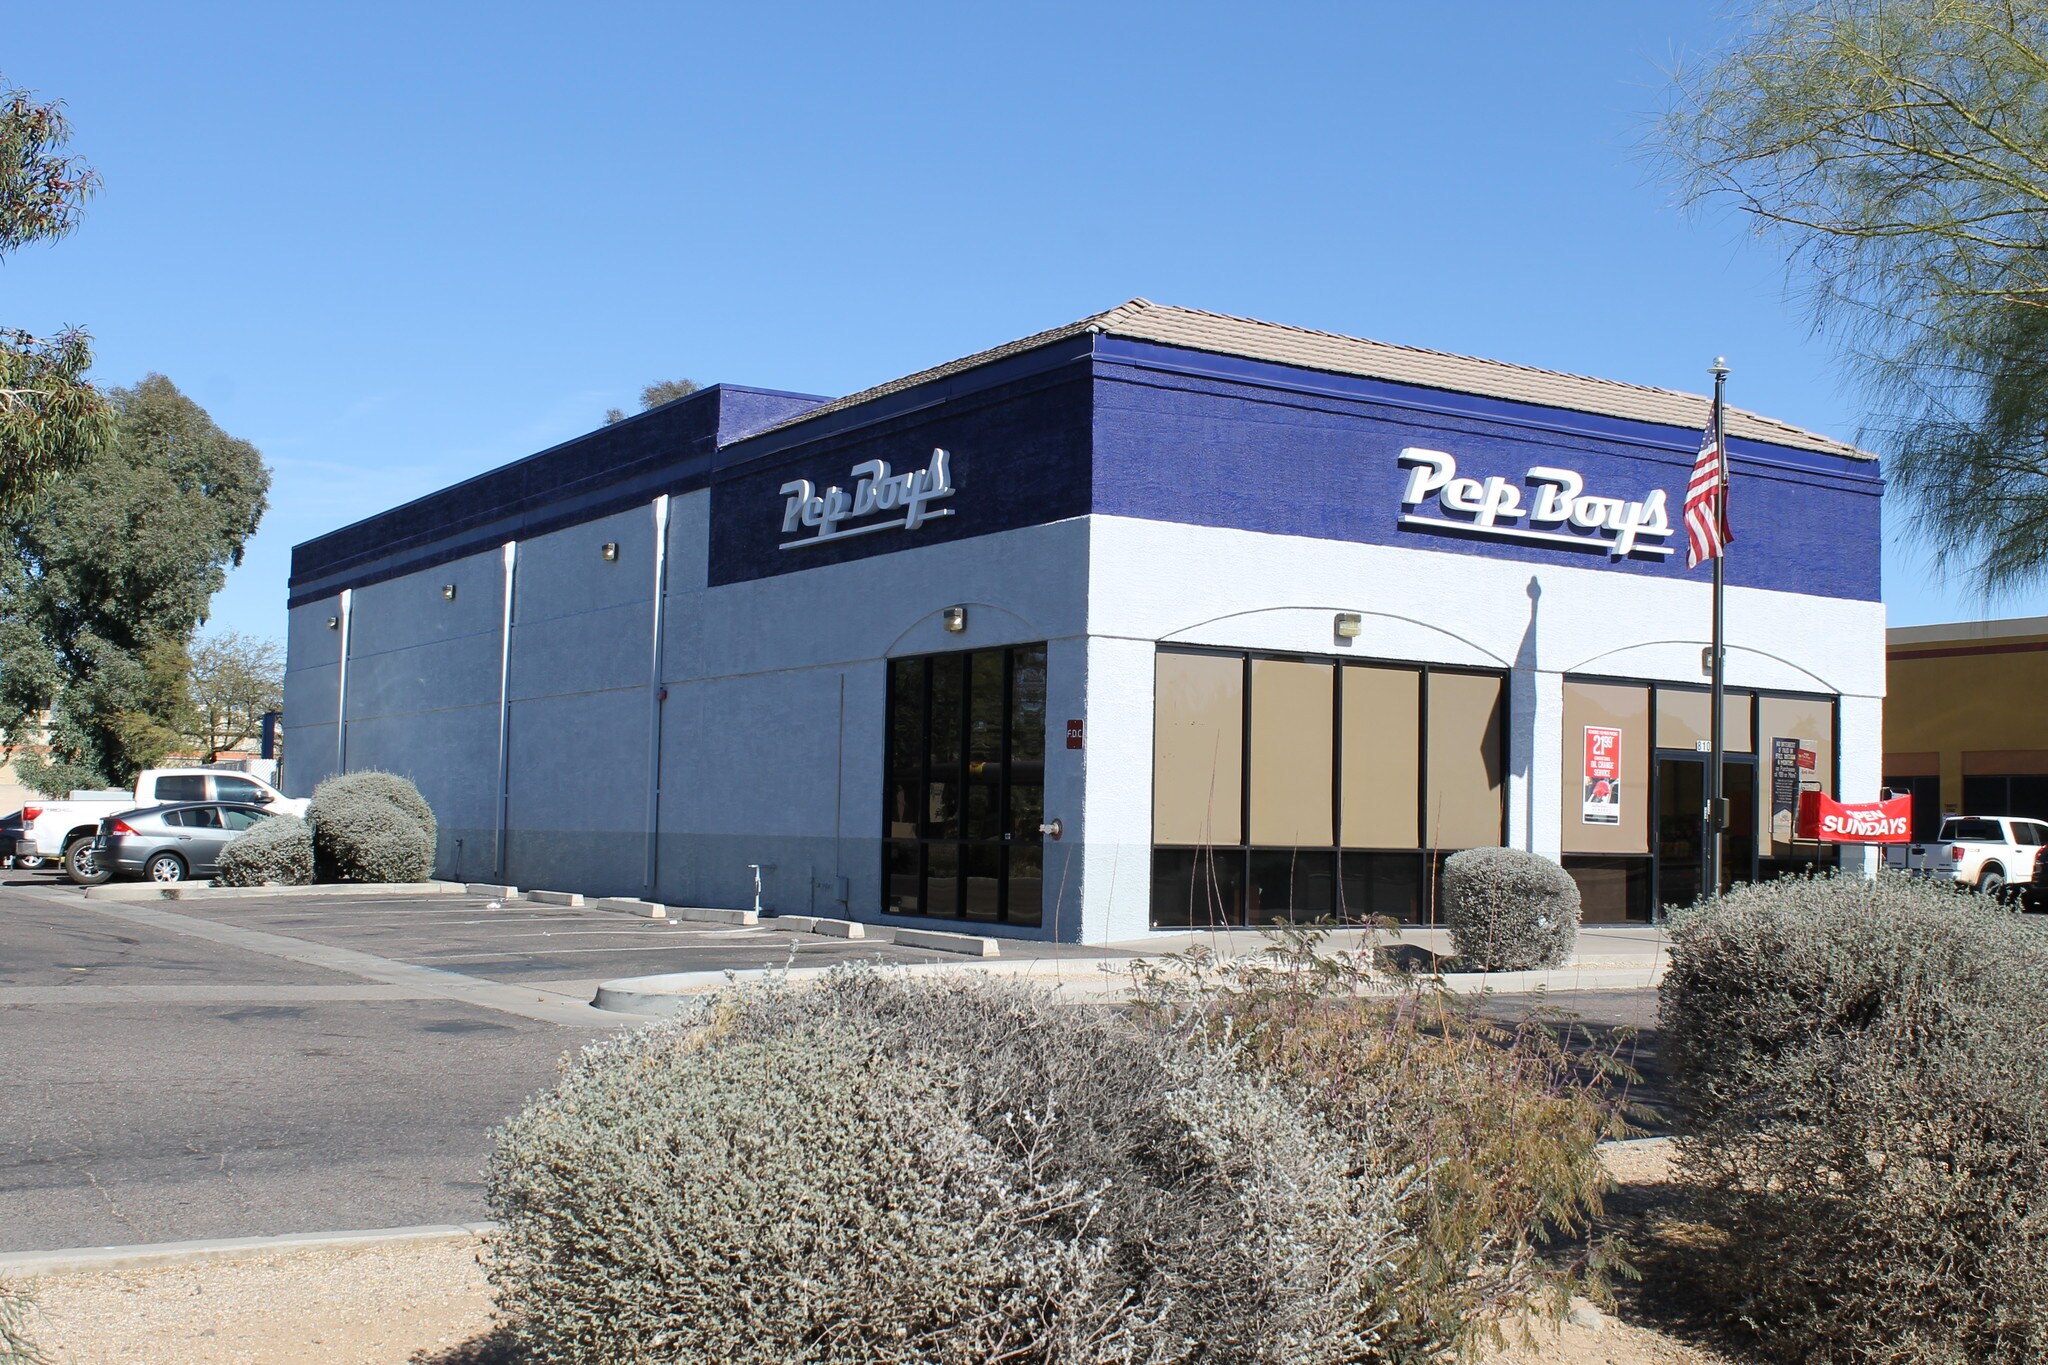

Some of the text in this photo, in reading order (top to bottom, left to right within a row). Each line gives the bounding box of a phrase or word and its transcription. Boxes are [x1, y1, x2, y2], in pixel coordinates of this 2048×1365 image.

[779, 447, 956, 537] Pep Boys
[1398, 447, 1675, 555] Pep Boys
[1697, 741, 1711, 751] 810
[1822, 815, 1907, 836] SUNDAYS
[1846, 810, 1887, 821] OPEN
